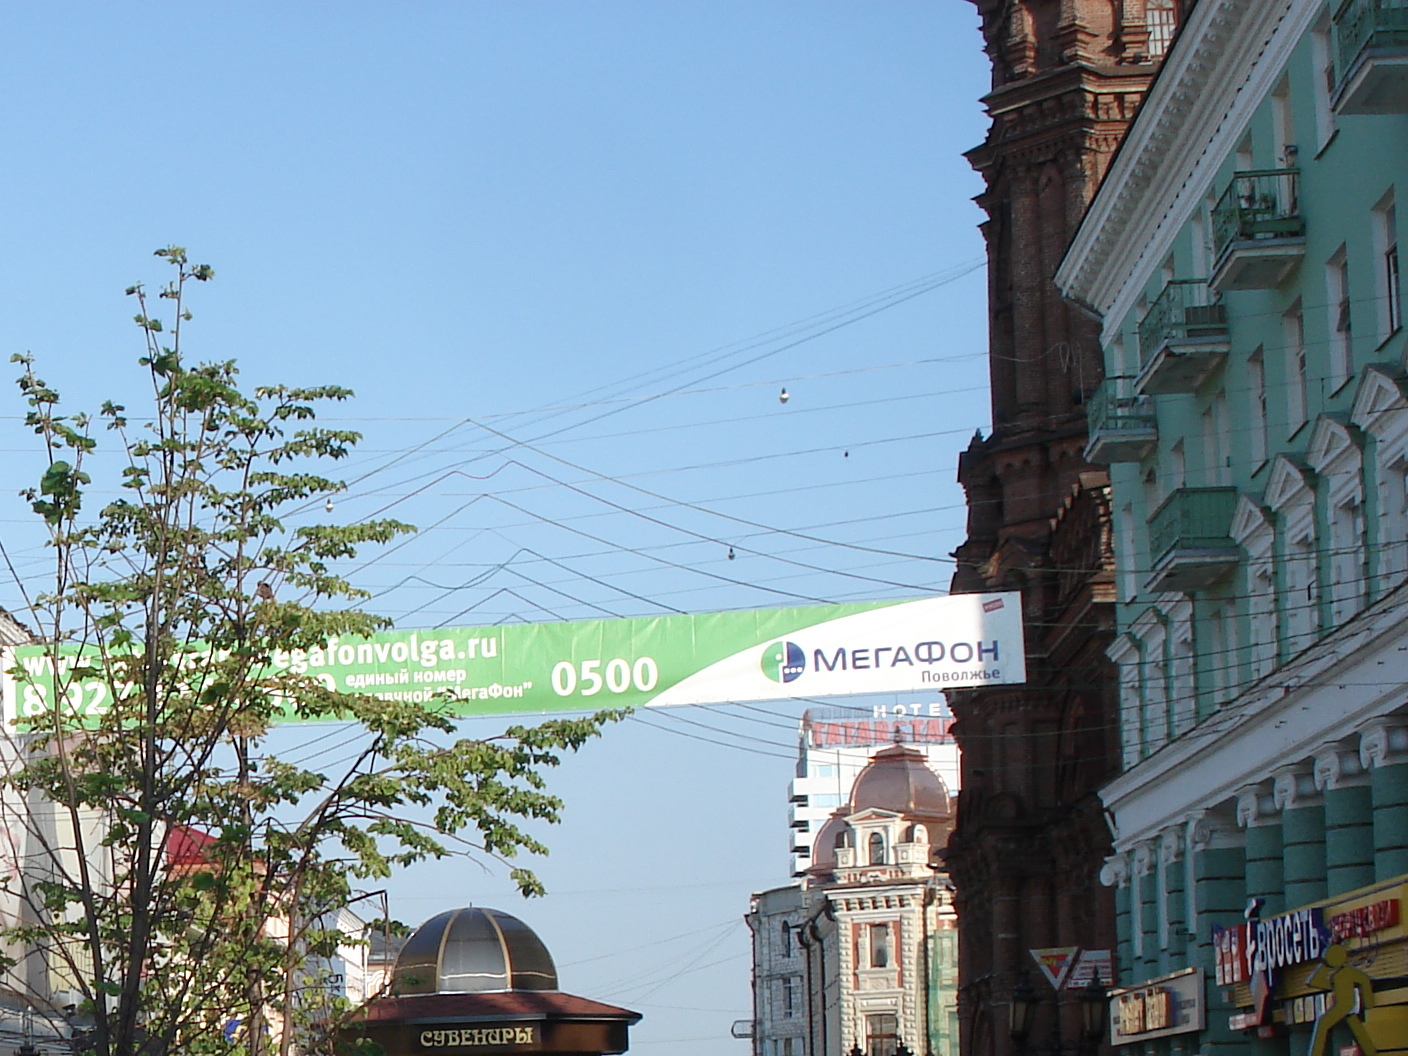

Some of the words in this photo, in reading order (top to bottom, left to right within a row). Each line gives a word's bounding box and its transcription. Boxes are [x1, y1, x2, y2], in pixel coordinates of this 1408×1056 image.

[345, 668, 409, 688] единый
[414, 669, 466, 685] номер
[552, 656, 658, 697] 0500
[922, 668, 1001, 682] Поволжье
[873, 703, 956, 718] HOTE
[420, 1026, 534, 1047] СУВЕНИРЫ
